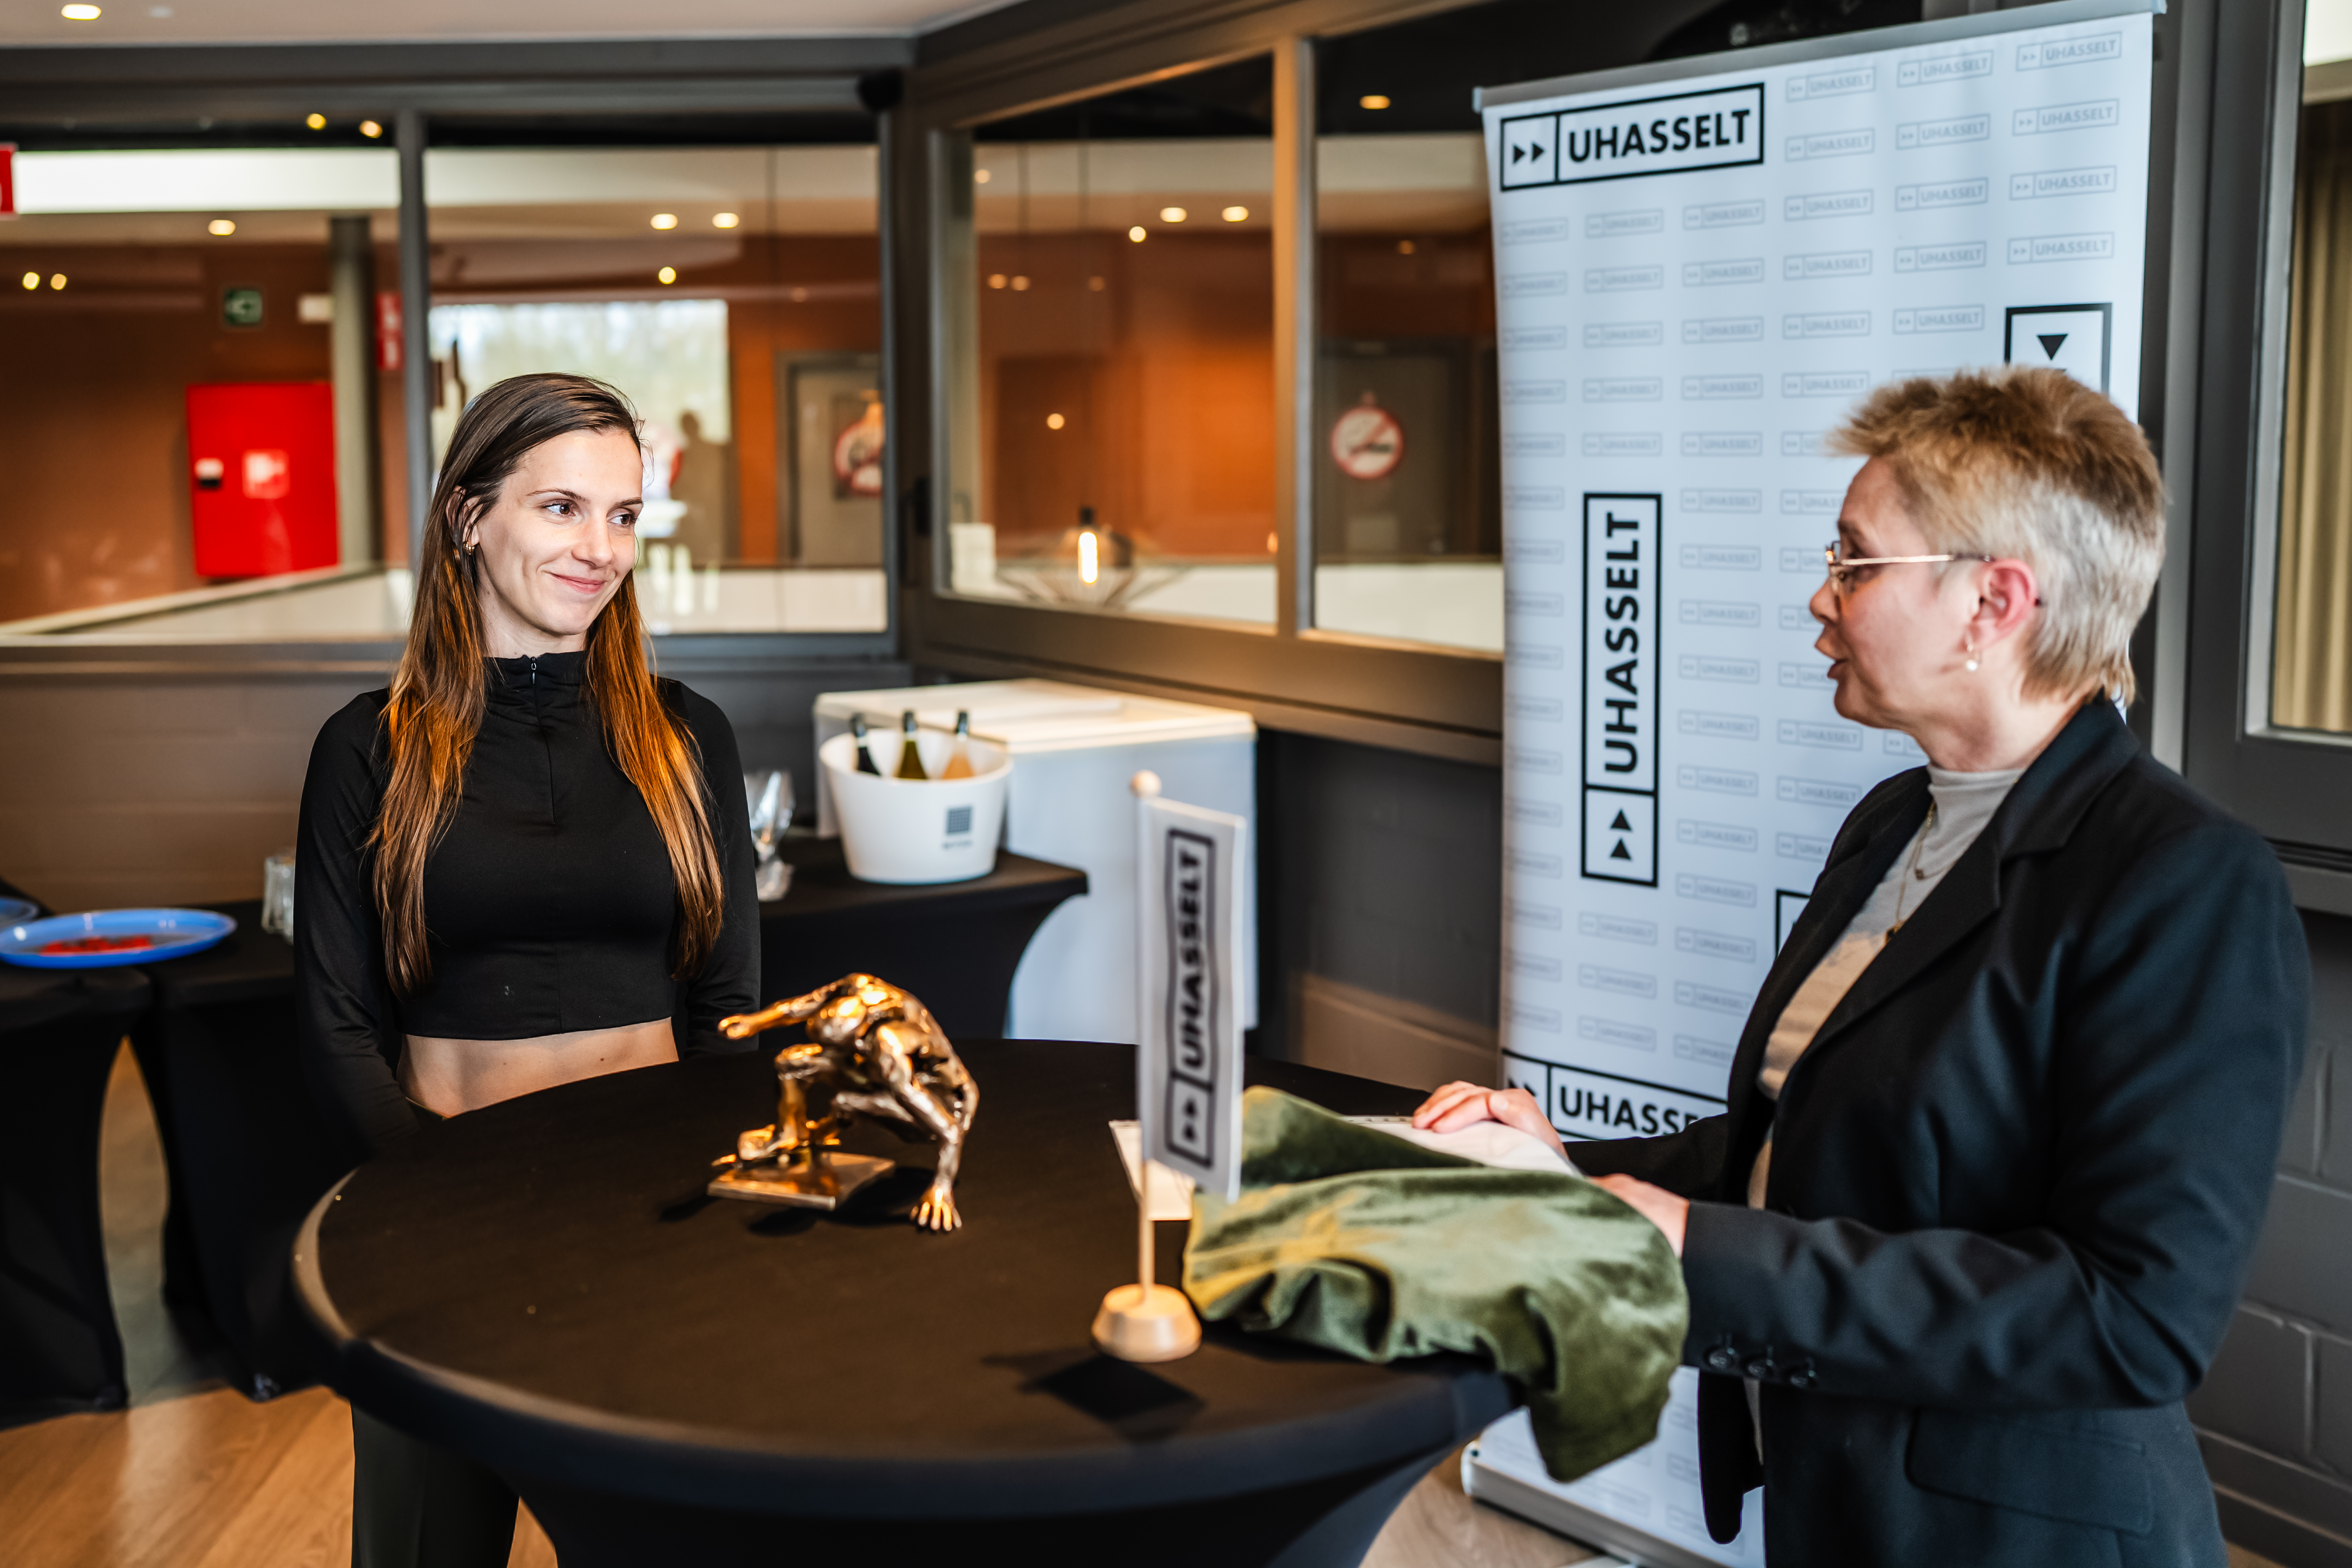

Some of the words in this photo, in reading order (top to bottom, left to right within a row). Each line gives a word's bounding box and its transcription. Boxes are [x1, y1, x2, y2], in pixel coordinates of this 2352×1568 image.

[2046, 40, 2116, 60] UHASSELT
[1924, 58, 1987, 77] UHASSELT
[2042, 108, 2113, 126] UHASSELT
[1569, 109, 1751, 163] UHASSELT
[1922, 122, 1985, 140] UHASSELT
[2038, 174, 2110, 190] UHASSELT
[1921, 185, 1984, 202] UHASSELT
[1920, 249, 1981, 264] UHASSELT
[2036, 240, 2107, 255] UHASSELT
[1919, 312, 1980, 327] UHASSELT
[1604, 510, 1640, 774] UHASSELT
[1179, 851, 1205, 1070] UHASSELT
[1561, 1085, 1698, 1135] UHASS
